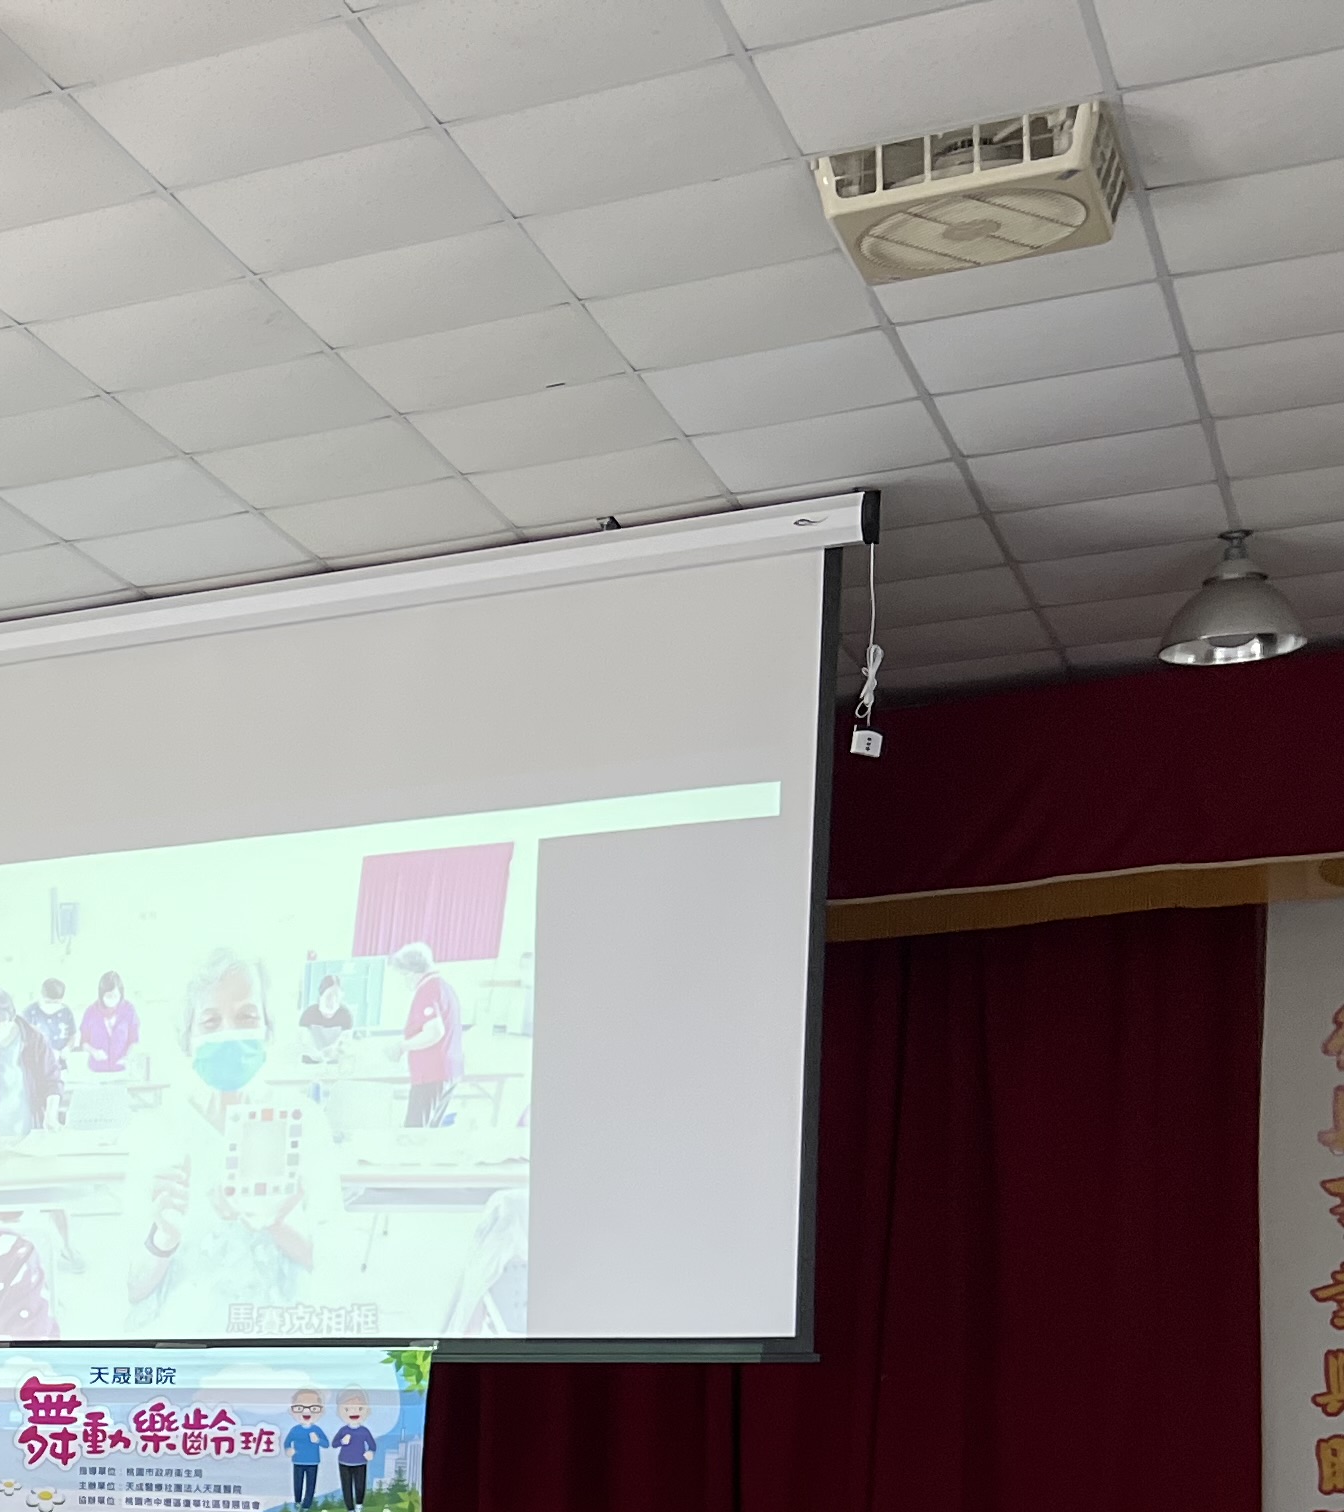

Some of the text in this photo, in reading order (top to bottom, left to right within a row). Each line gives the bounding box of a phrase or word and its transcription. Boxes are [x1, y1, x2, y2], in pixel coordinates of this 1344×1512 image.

[226, 1302, 379, 1335] 馬賽克相框
[89, 1366, 177, 1385] 天晟醫院
[17, 1376, 276, 1466] 舞動樂齡班
